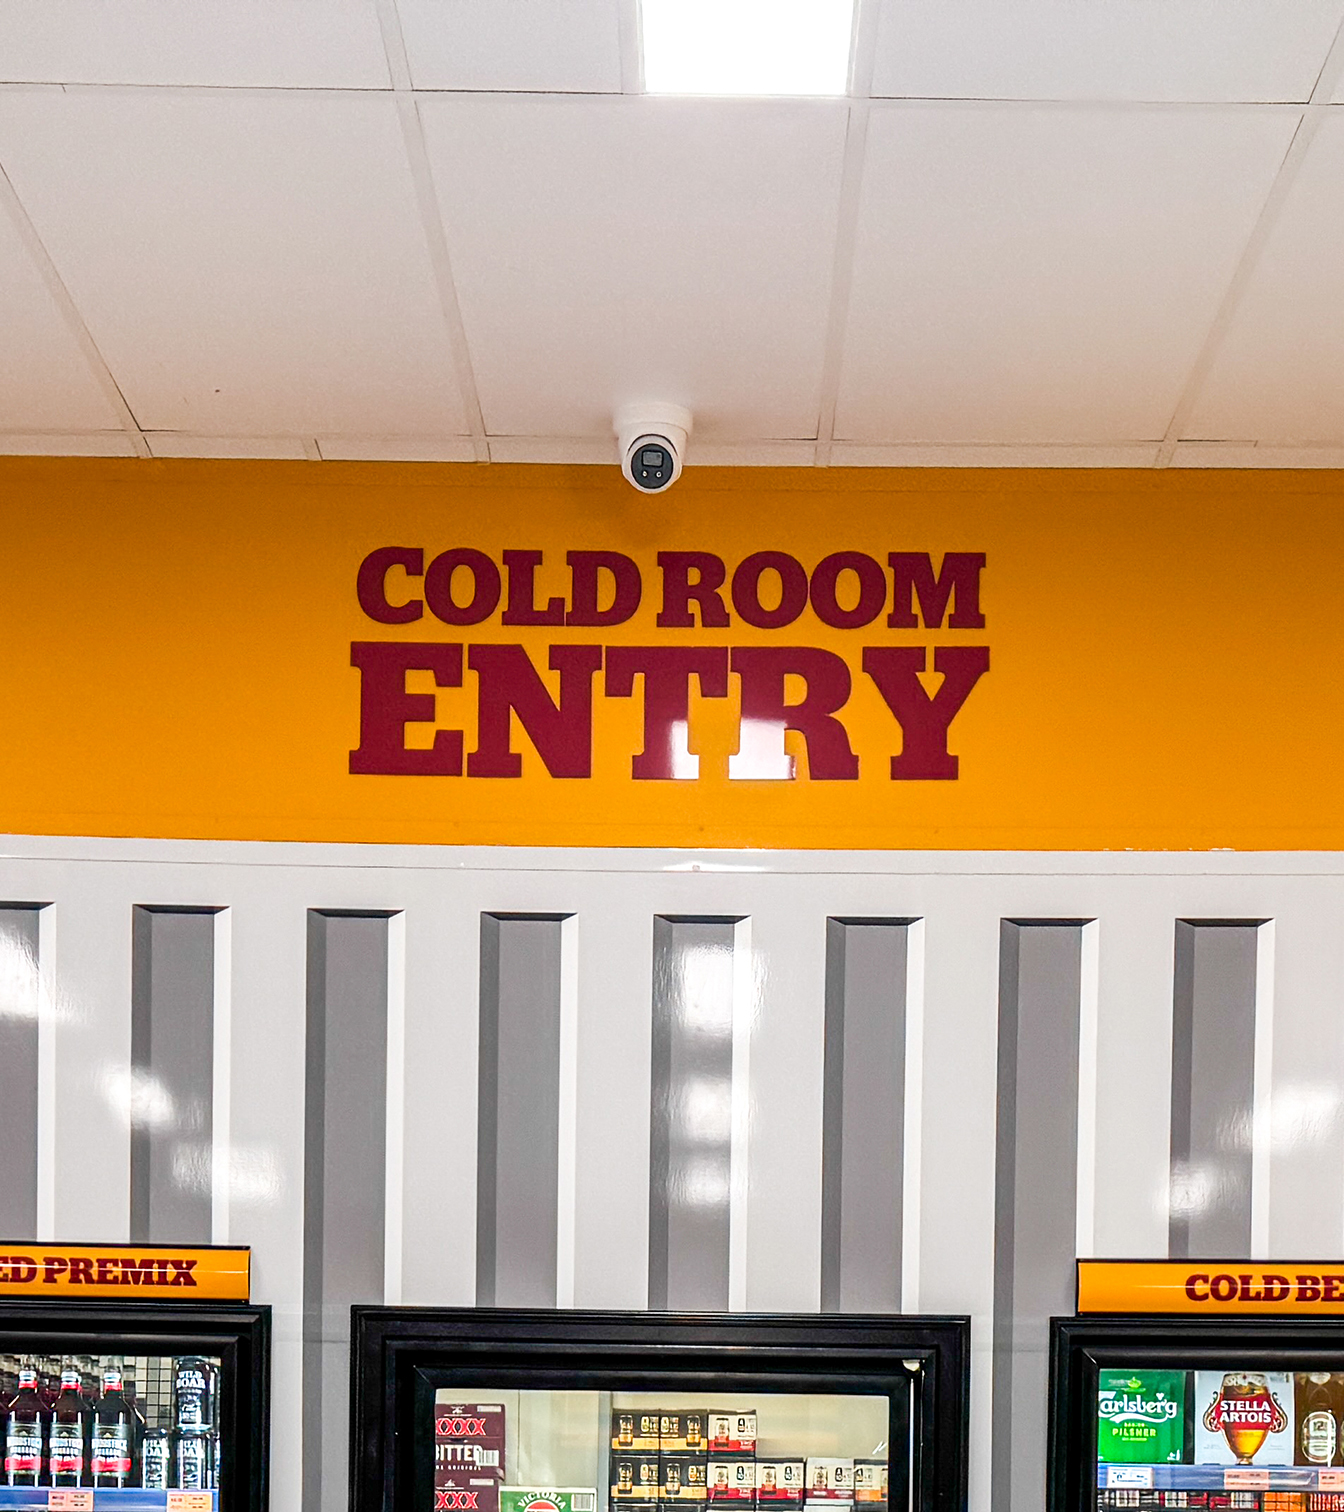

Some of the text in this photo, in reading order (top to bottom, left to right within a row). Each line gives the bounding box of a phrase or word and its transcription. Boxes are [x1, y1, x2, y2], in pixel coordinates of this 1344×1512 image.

[356, 546, 988, 629] COLD ROOM
[349, 641, 990, 780] ENTRY
[43, 1256, 199, 1287] PREMIX
[1185, 1273, 1290, 1302] COLD
[1220, 1400, 1272, 1412] STELLA
[1220, 1412, 1272, 1424] ARTOIS
[1112, 1428, 1157, 1438] PILSNER
[517, 1491, 567, 1510] VICTORIA
